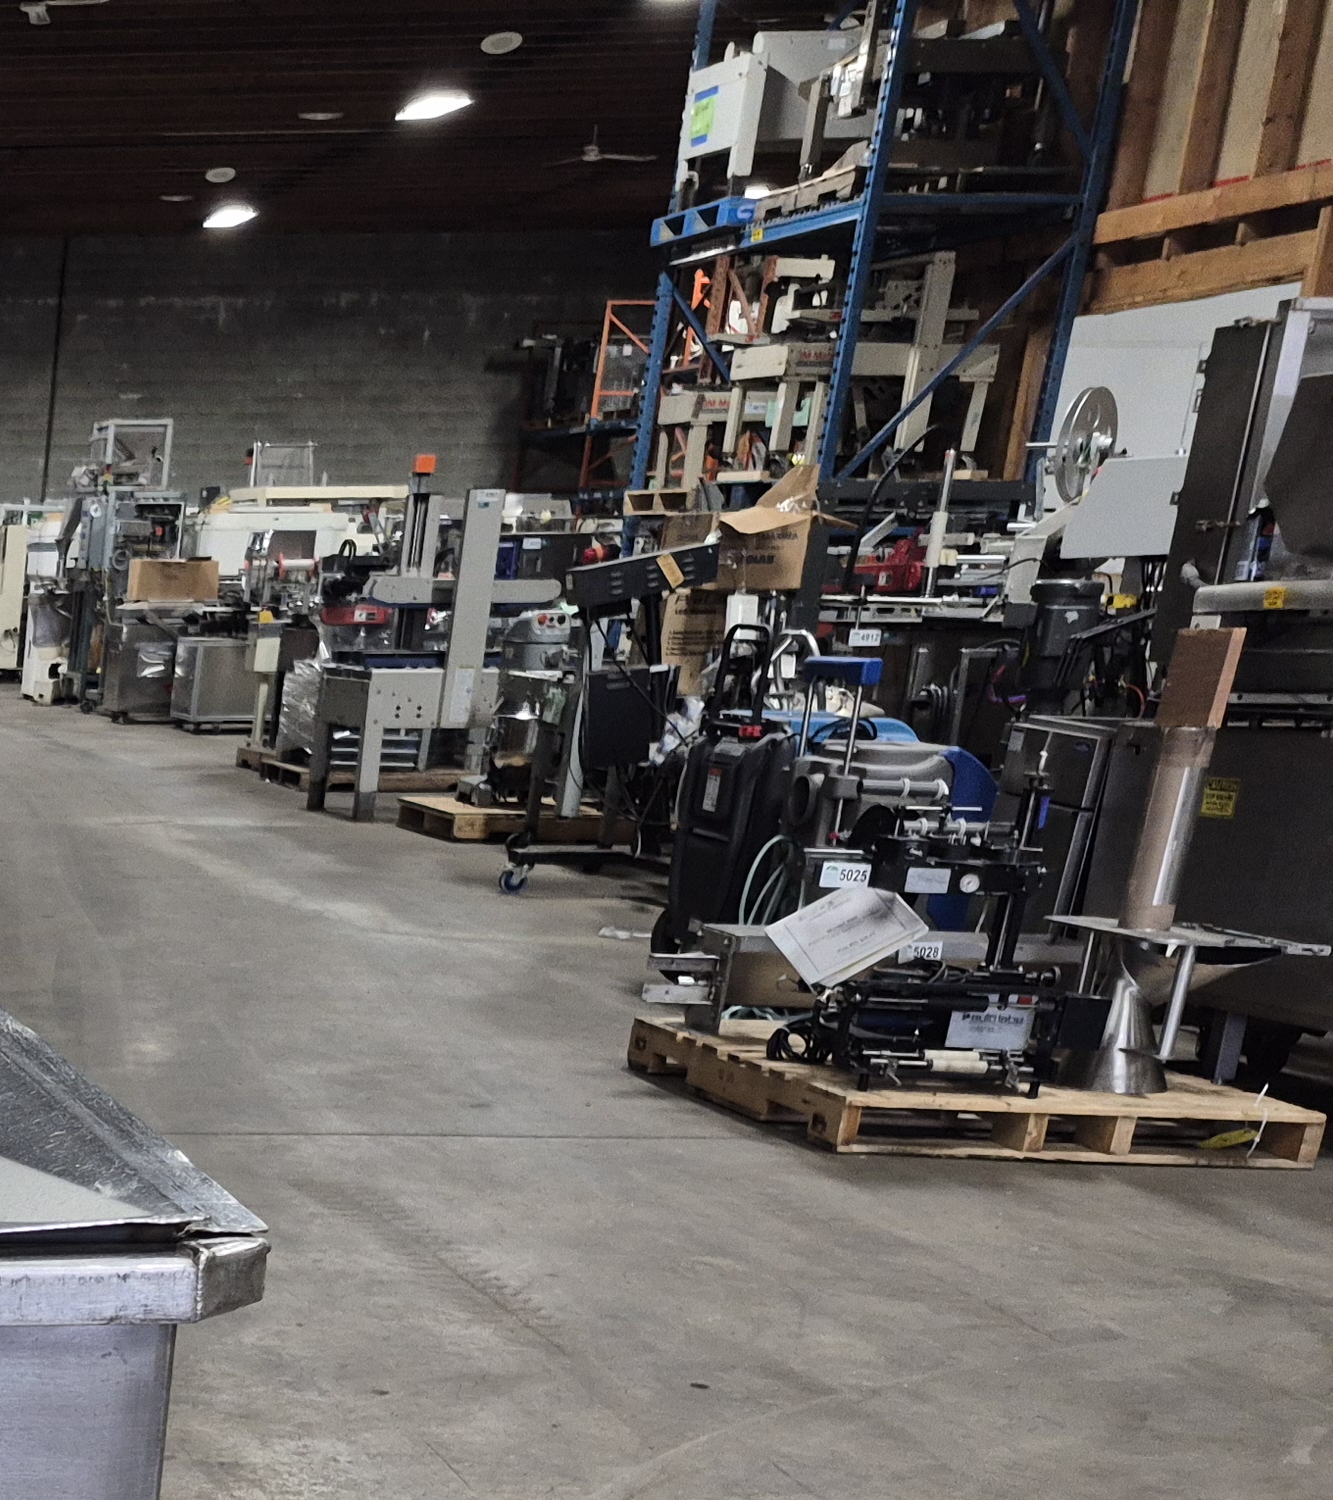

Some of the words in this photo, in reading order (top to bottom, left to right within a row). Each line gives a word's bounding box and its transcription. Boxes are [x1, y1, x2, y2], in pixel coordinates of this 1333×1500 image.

[861, 633, 880, 642] 4912
[839, 869, 868, 883] 5025
[913, 946, 939, 958] 5028
